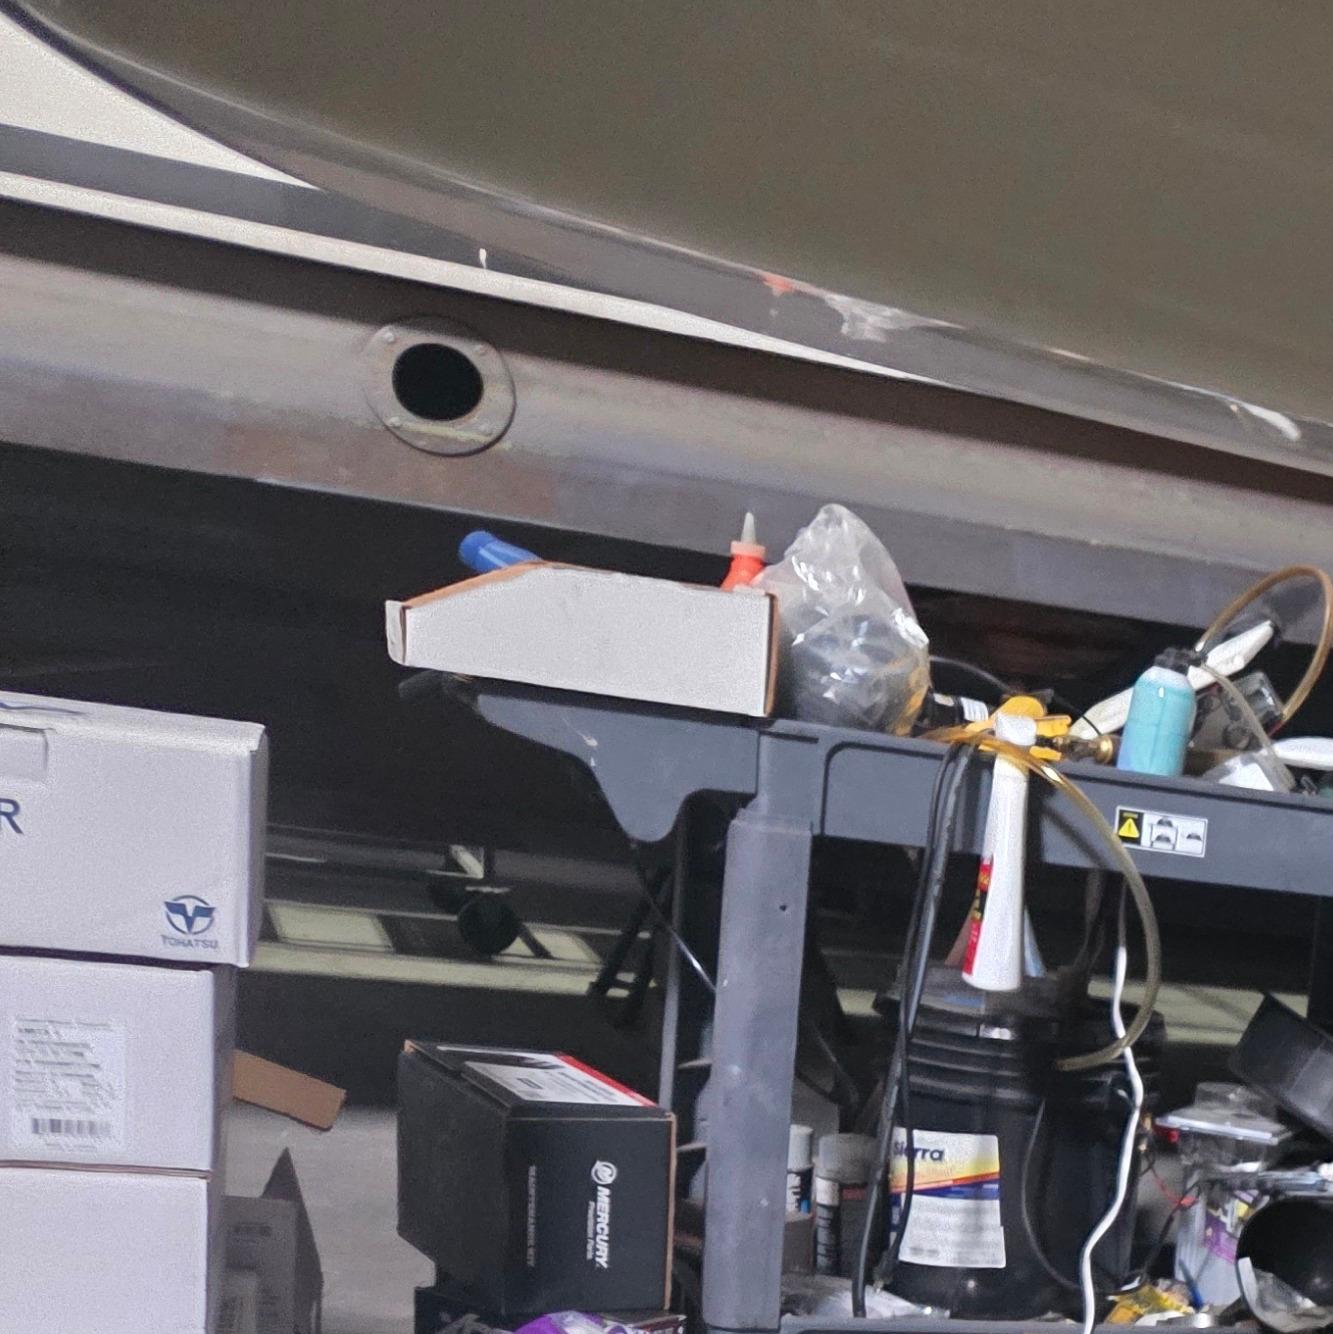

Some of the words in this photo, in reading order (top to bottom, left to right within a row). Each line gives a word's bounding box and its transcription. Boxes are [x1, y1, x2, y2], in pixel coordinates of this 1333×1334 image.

[161, 934, 219, 949] TOHATSU
[894, 1141, 944, 1162] Sirra
[594, 1185, 612, 1269] MERCURY
